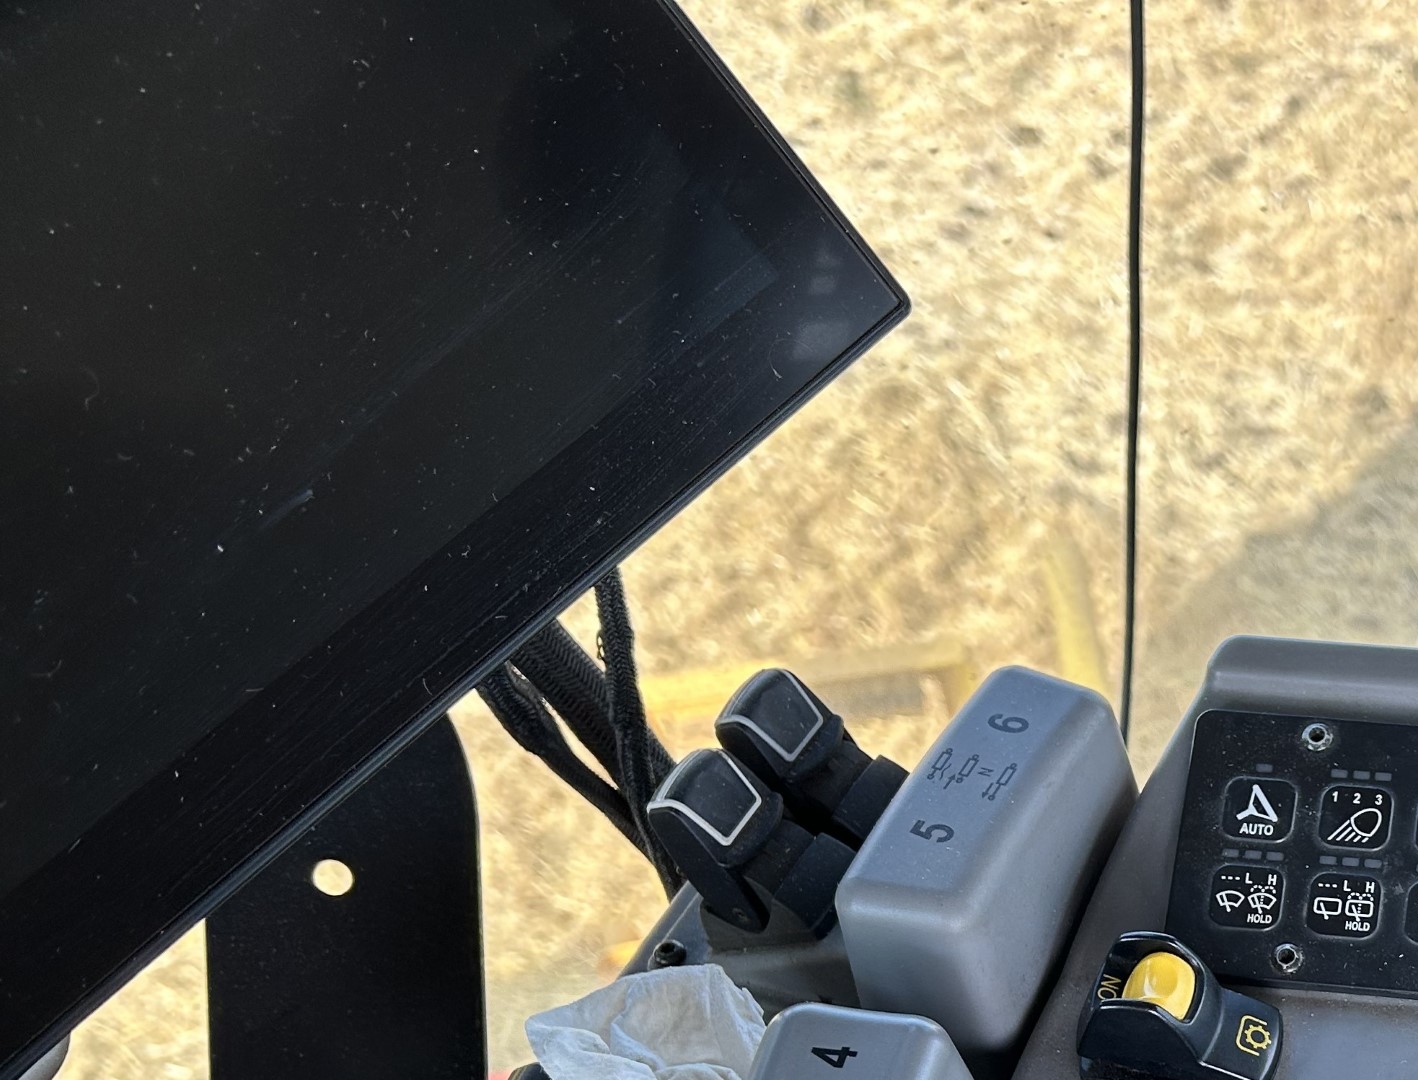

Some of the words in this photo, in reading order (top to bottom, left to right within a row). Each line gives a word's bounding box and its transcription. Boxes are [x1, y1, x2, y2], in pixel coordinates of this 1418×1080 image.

[988, 714, 1029, 733] 6
[978, 768, 993, 776] N
[1333, 791, 1338, 802] 1
[1353, 793, 1360, 803] 2
[1375, 795, 1382, 805] 3
[910, 820, 954, 842] 5
[1240, 823, 1273, 835] AUTO
[1246, 873, 1252, 883] L
[1268, 874, 1276, 885] H
[1344, 880, 1351, 891] L
[1366, 882, 1375, 893] H
[1247, 914, 1272, 923] HOLD
[1345, 921, 1371, 932] HOLD
[1098, 974, 1121, 1000] ON
[811, 1047, 857, 1068] 4
